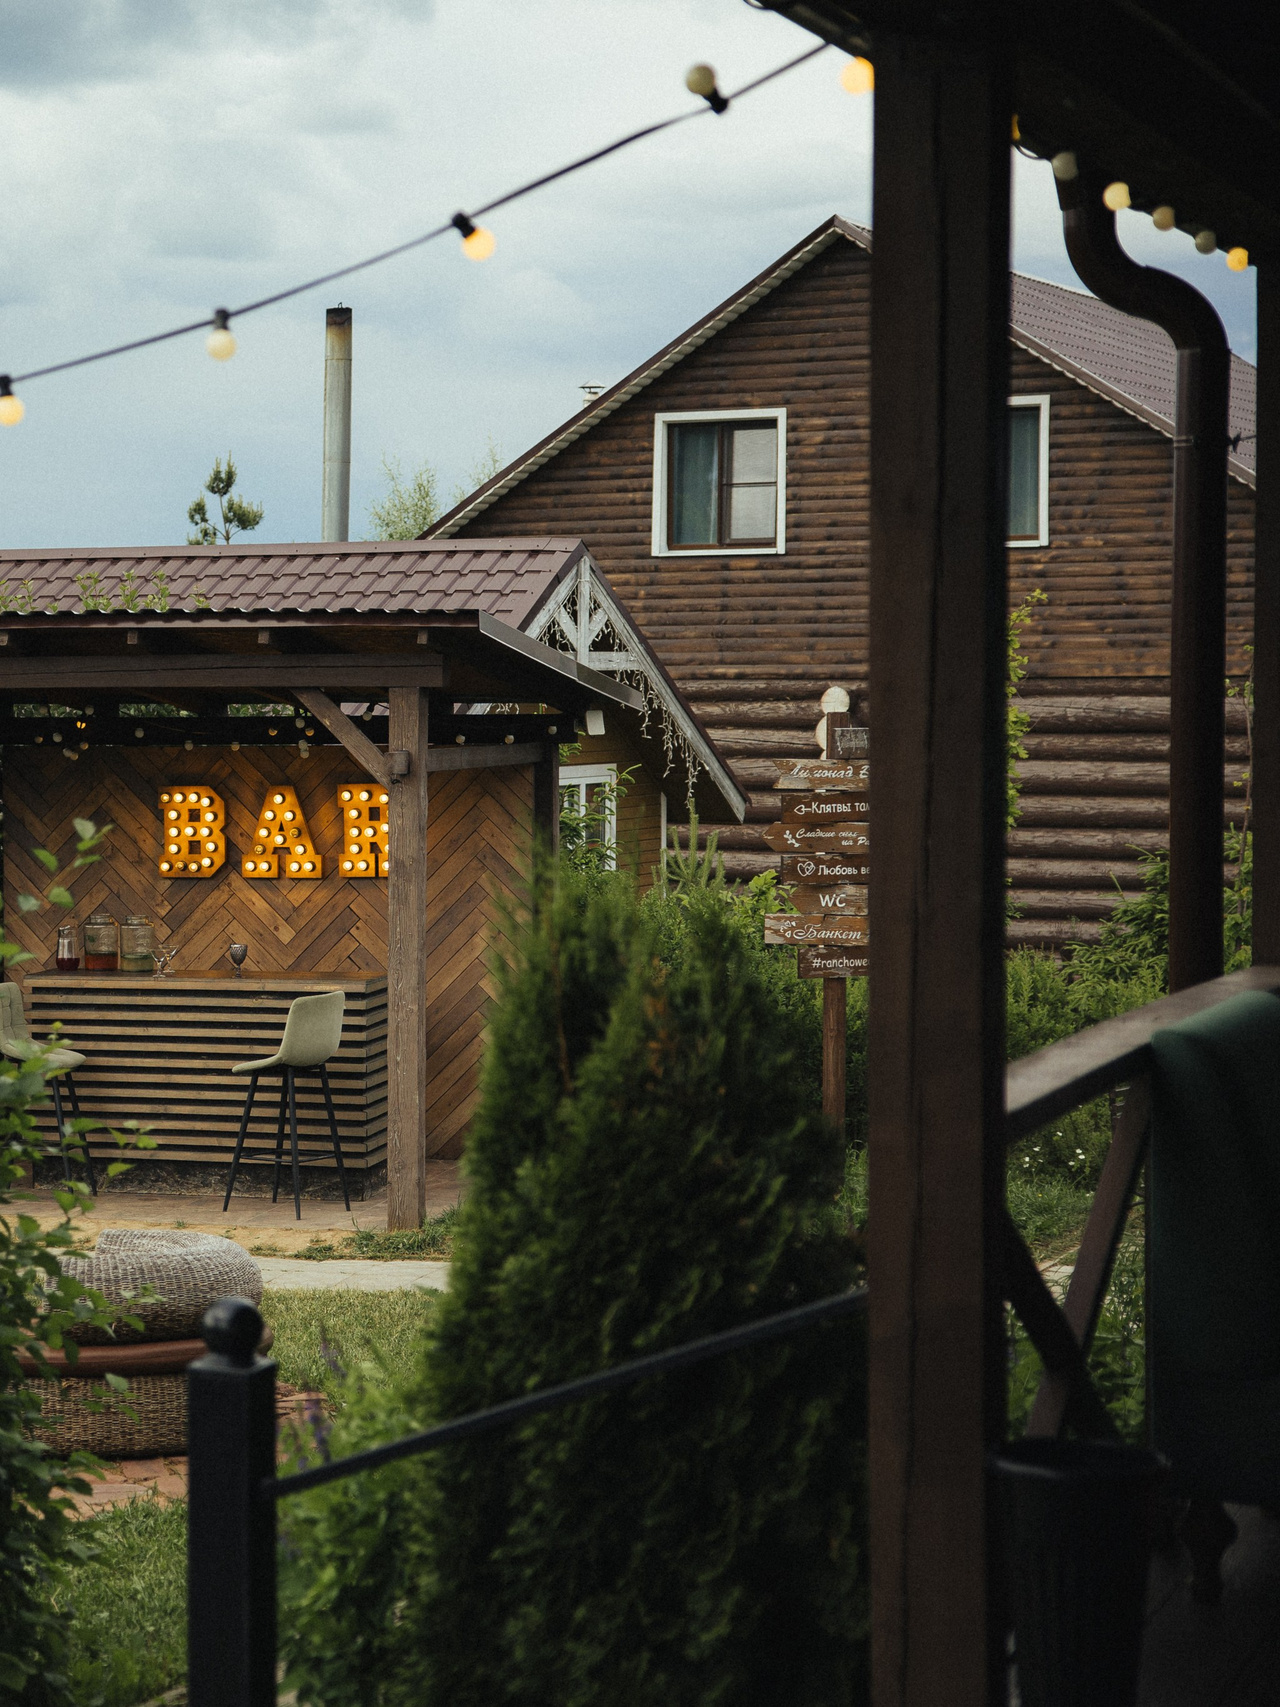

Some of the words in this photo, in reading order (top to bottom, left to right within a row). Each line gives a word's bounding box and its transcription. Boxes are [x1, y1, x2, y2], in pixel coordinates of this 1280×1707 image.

[790, 765, 853, 779] Лимонад
[811, 802, 852, 813] Клятвы
[158, 784, 389, 878] BAR
[795, 828, 836, 839] Сладкие
[838, 831, 858, 839] сны
[841, 838, 854, 846] на
[817, 865, 858, 876] Любовь
[819, 893, 846, 907] WC
[793, 923, 862, 939] Банкет
[812, 956, 870, 969] #ranchowe
